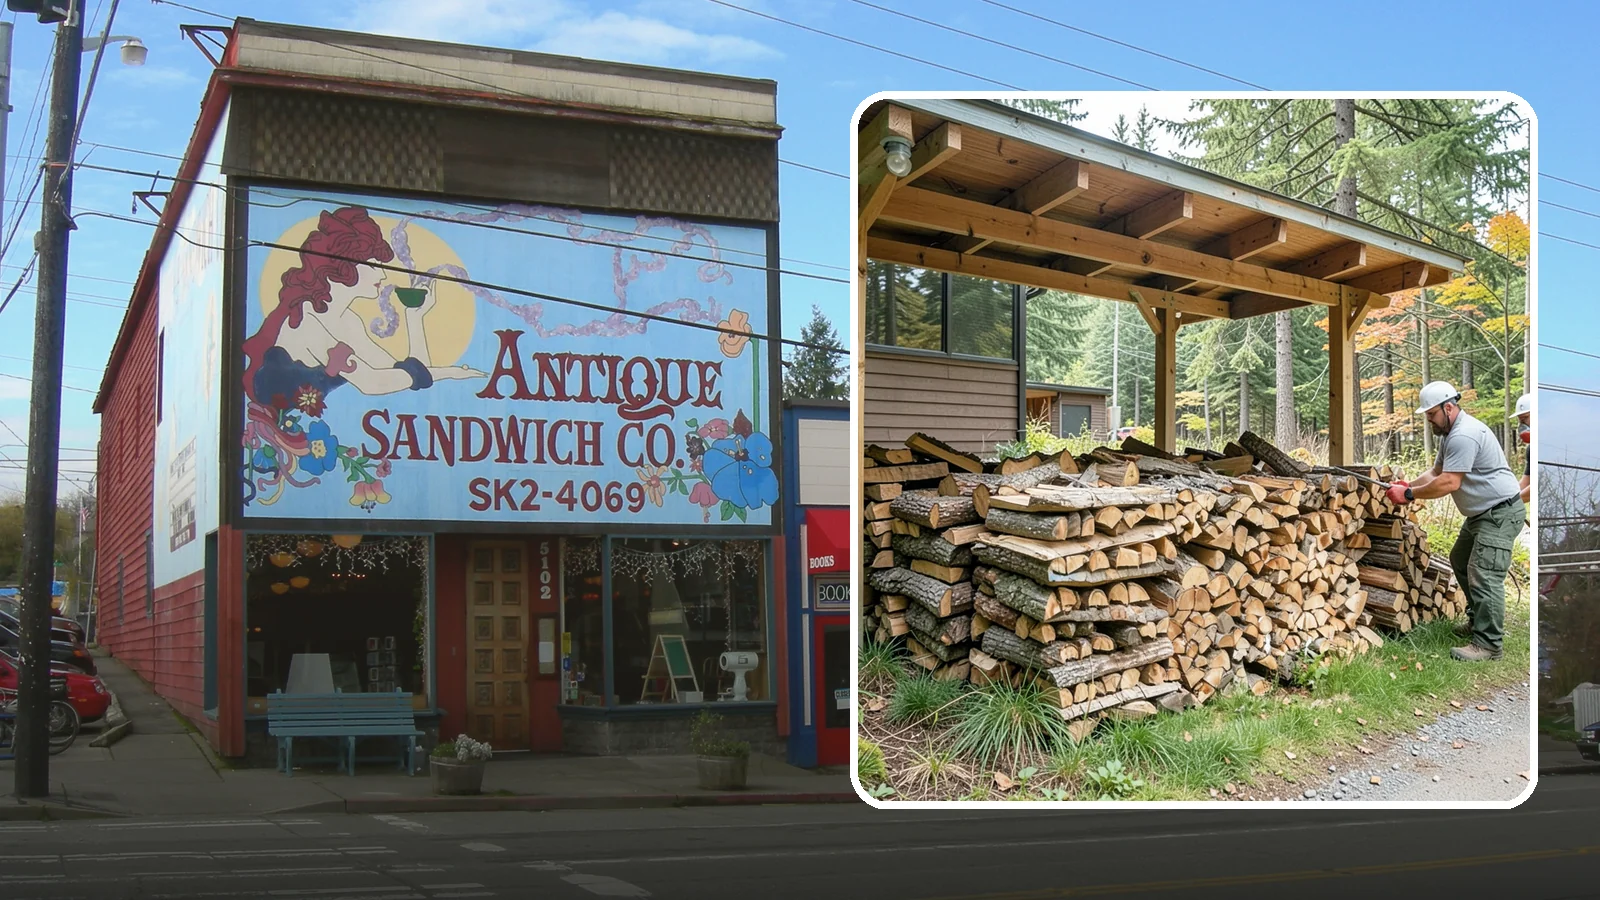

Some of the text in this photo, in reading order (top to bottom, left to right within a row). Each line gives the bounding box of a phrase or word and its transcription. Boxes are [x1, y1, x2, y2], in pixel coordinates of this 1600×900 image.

[476, 330, 723, 421] ANTIQUE
[361, 409, 686, 470] SANDWICH CO.
[469, 477, 645, 513] SK2-4069
[539, 541, 552, 600] 5102
[809, 554, 835, 569] BOOKS
